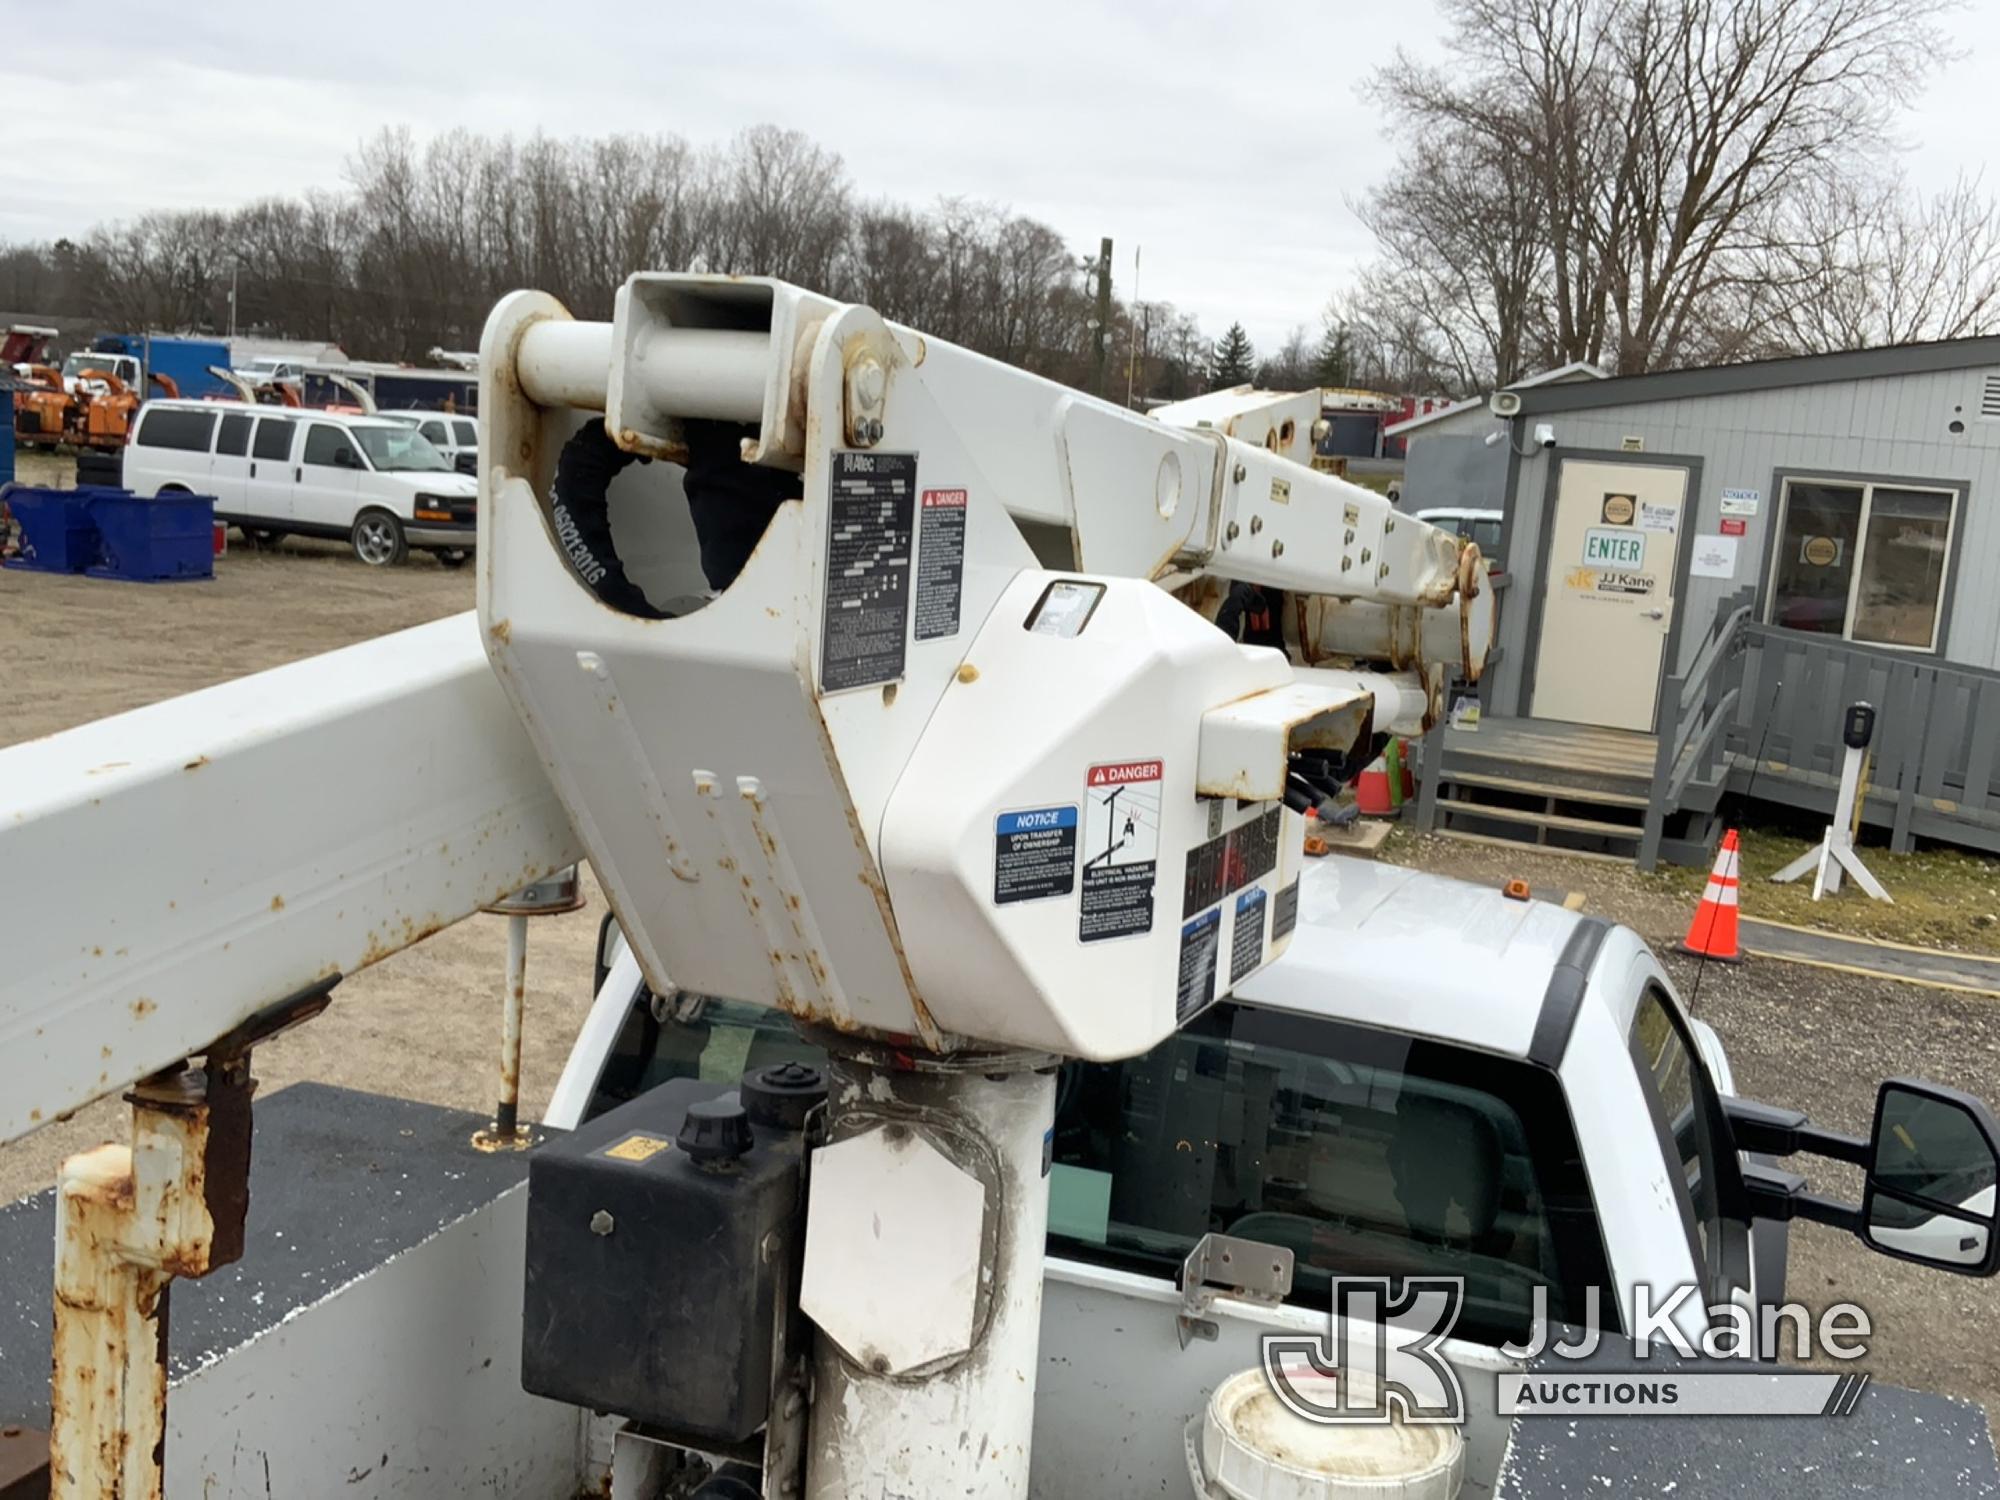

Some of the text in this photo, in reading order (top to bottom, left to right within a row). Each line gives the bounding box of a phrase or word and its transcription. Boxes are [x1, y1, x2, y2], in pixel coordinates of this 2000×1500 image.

[936, 491, 965, 505] DANGER
[1588, 536, 1640, 562] ENTER
[1600, 572, 1654, 588] JJ Kane
[1109, 764, 1158, 781] DANGER
[1017, 811, 1059, 828] NOTICE
[1010, 829, 1064, 842] UPON TRANSFER
[1012, 838, 1061, 851] OF OWNERSHIP
